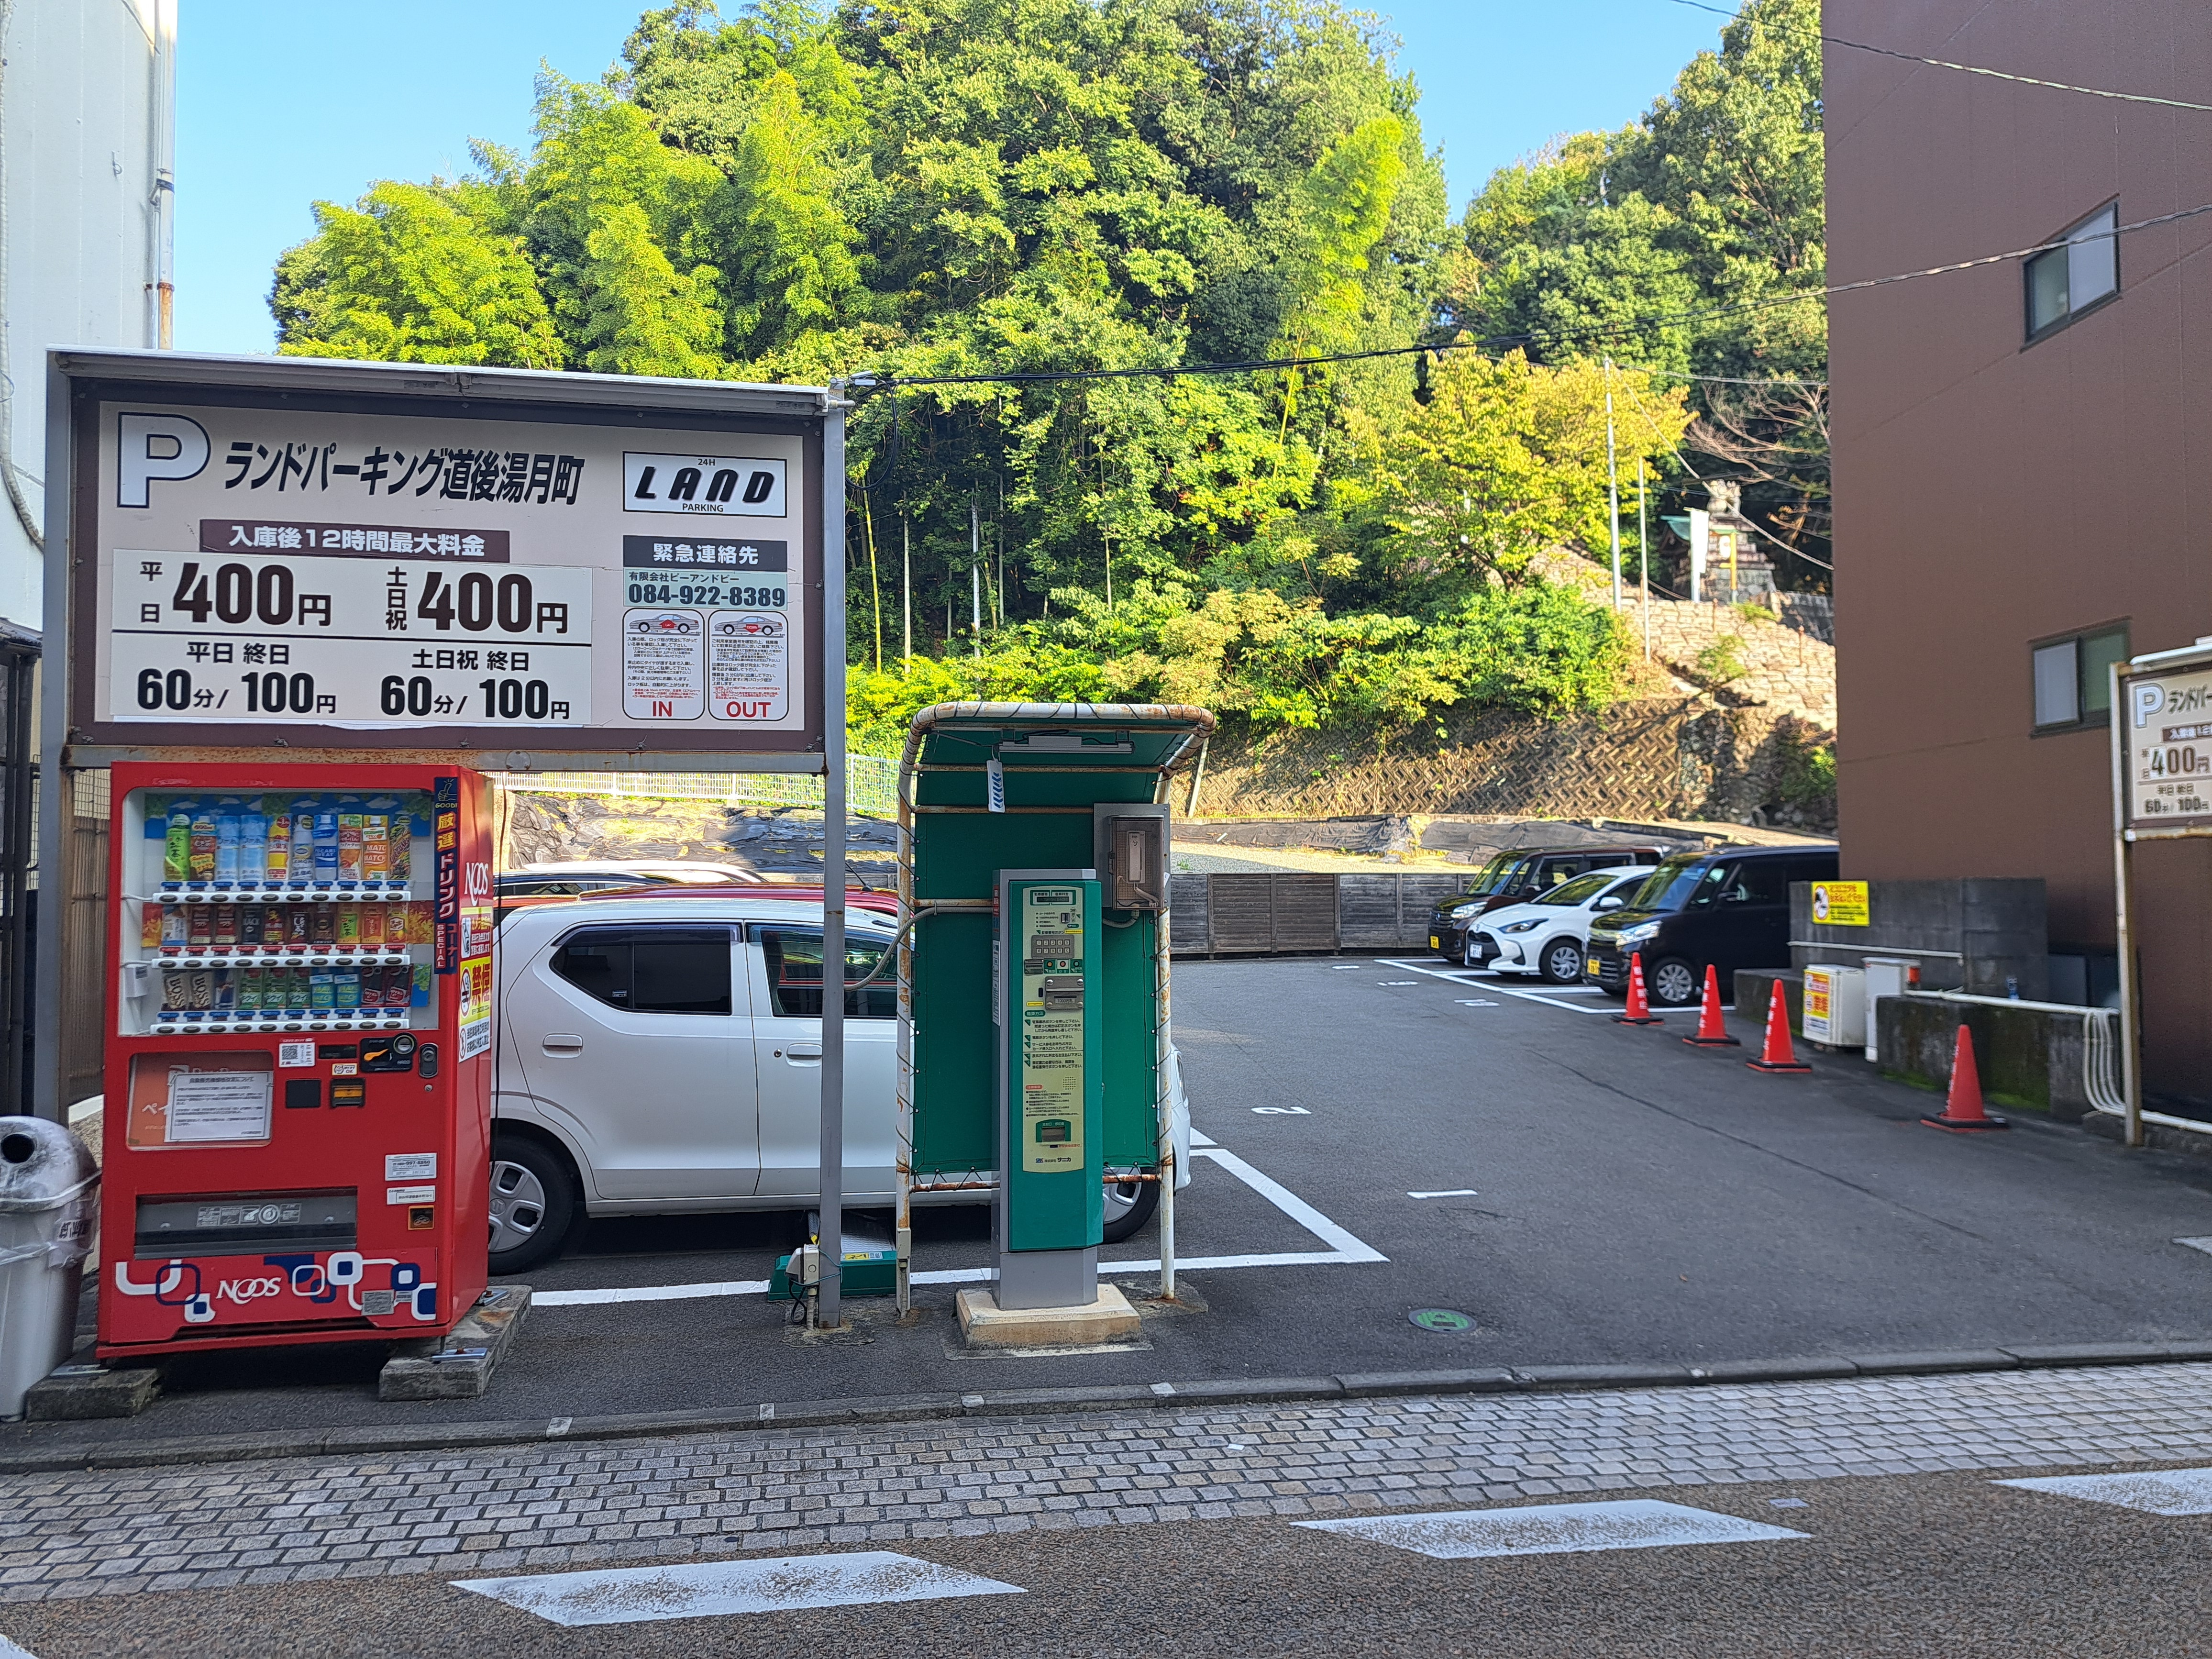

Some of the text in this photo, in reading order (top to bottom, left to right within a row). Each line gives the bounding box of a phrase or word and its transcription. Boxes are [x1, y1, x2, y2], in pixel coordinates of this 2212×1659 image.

[117, 411, 211, 508] P
[224, 442, 585, 505] ランドパーキング道後湯月町
[697, 458, 716, 466] 24H
[634, 466, 774, 503] LAND
[682, 503, 723, 512] PARKING
[228, 524, 485, 556] 入庫後12時間最大料金
[653, 543, 759, 565] 緊急連絡先
[629, 571, 740, 584] 有限会社ビーアンドビー
[172, 562, 332, 626] 400円
[417, 571, 568, 634] 400円
[628, 584, 785, 607] 084-922-8389
[187, 641, 290, 665] 平日 終日
[412, 649, 530, 672] 土日祝 終日
[653, 701, 672, 717] IN
[726, 701, 772, 718] OUT
[2135, 683, 2165, 728] P
[437, 812, 456, 919] 厳選ドリンク
[436, 924, 445, 967] SPECIAL
[447, 924, 457, 968] コーナー
[169, 978, 185, 1007] BOSS
[194, 977, 210, 1007] BOSS
[215, 1277, 283, 1305] NOOS
